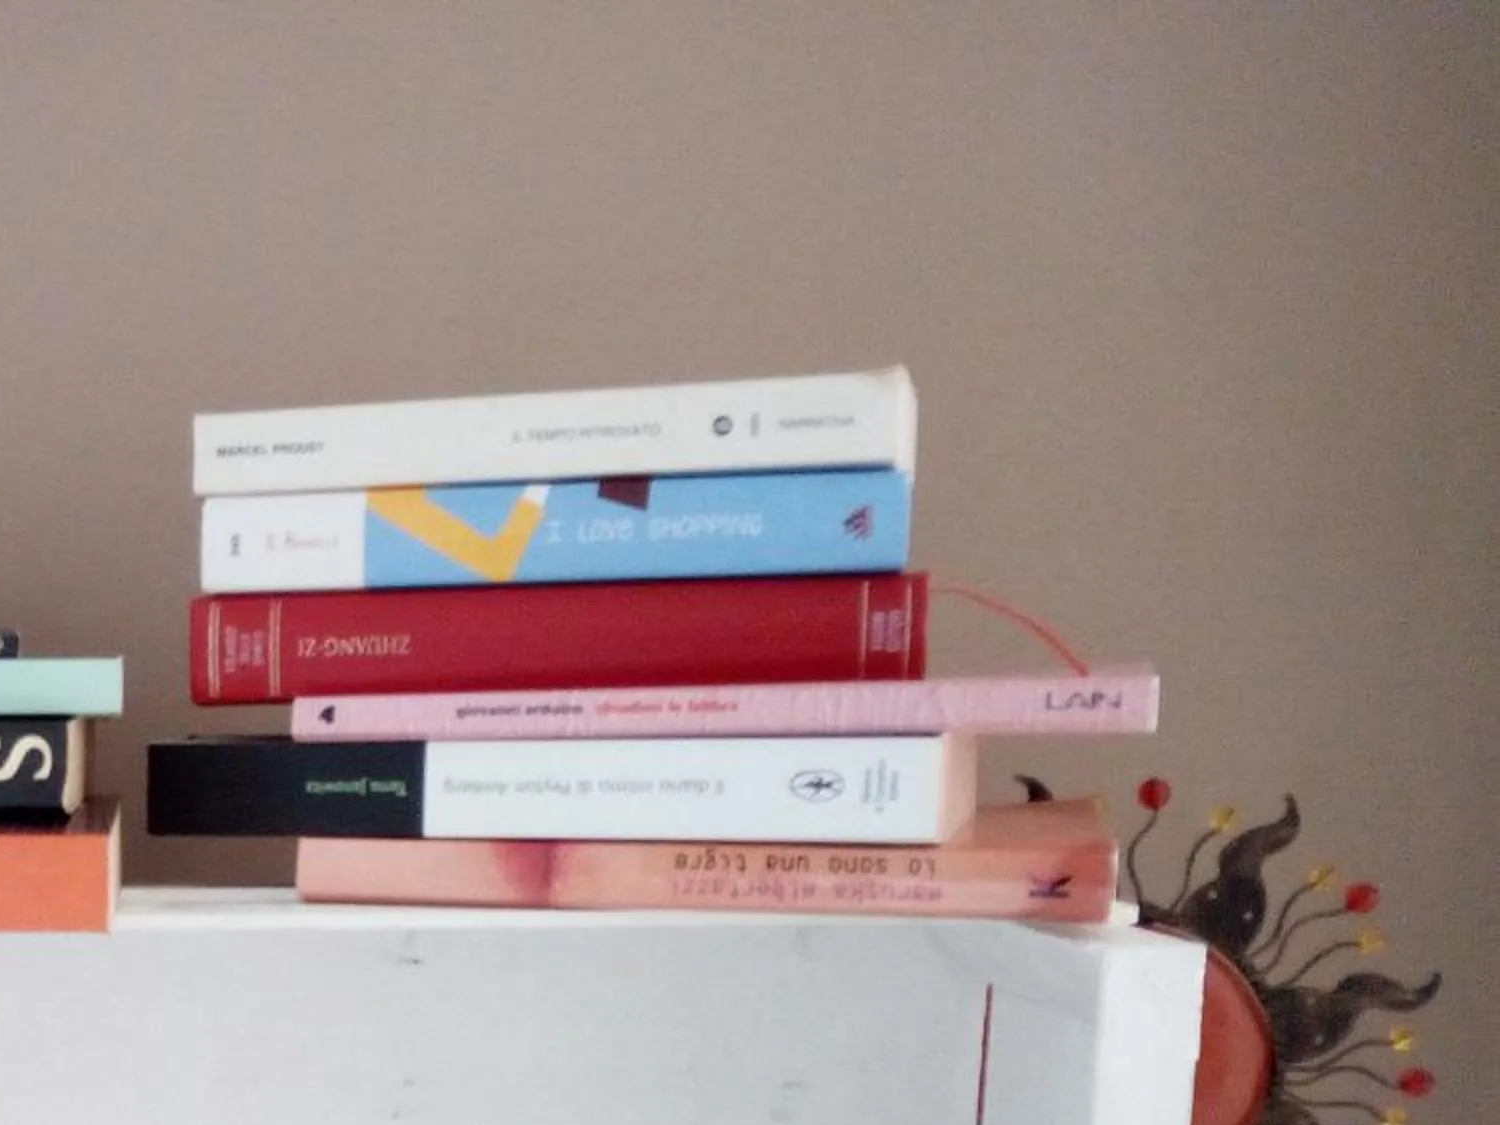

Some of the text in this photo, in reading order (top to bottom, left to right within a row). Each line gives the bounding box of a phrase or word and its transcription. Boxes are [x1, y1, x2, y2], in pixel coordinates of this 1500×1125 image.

[216, 441, 325, 458] MARCEL PROUST
[649, 511, 764, 539] SHOPPING
[674, 848, 747, 872] tigre
[766, 857, 810, 874] una
[828, 857, 888, 875] sono
